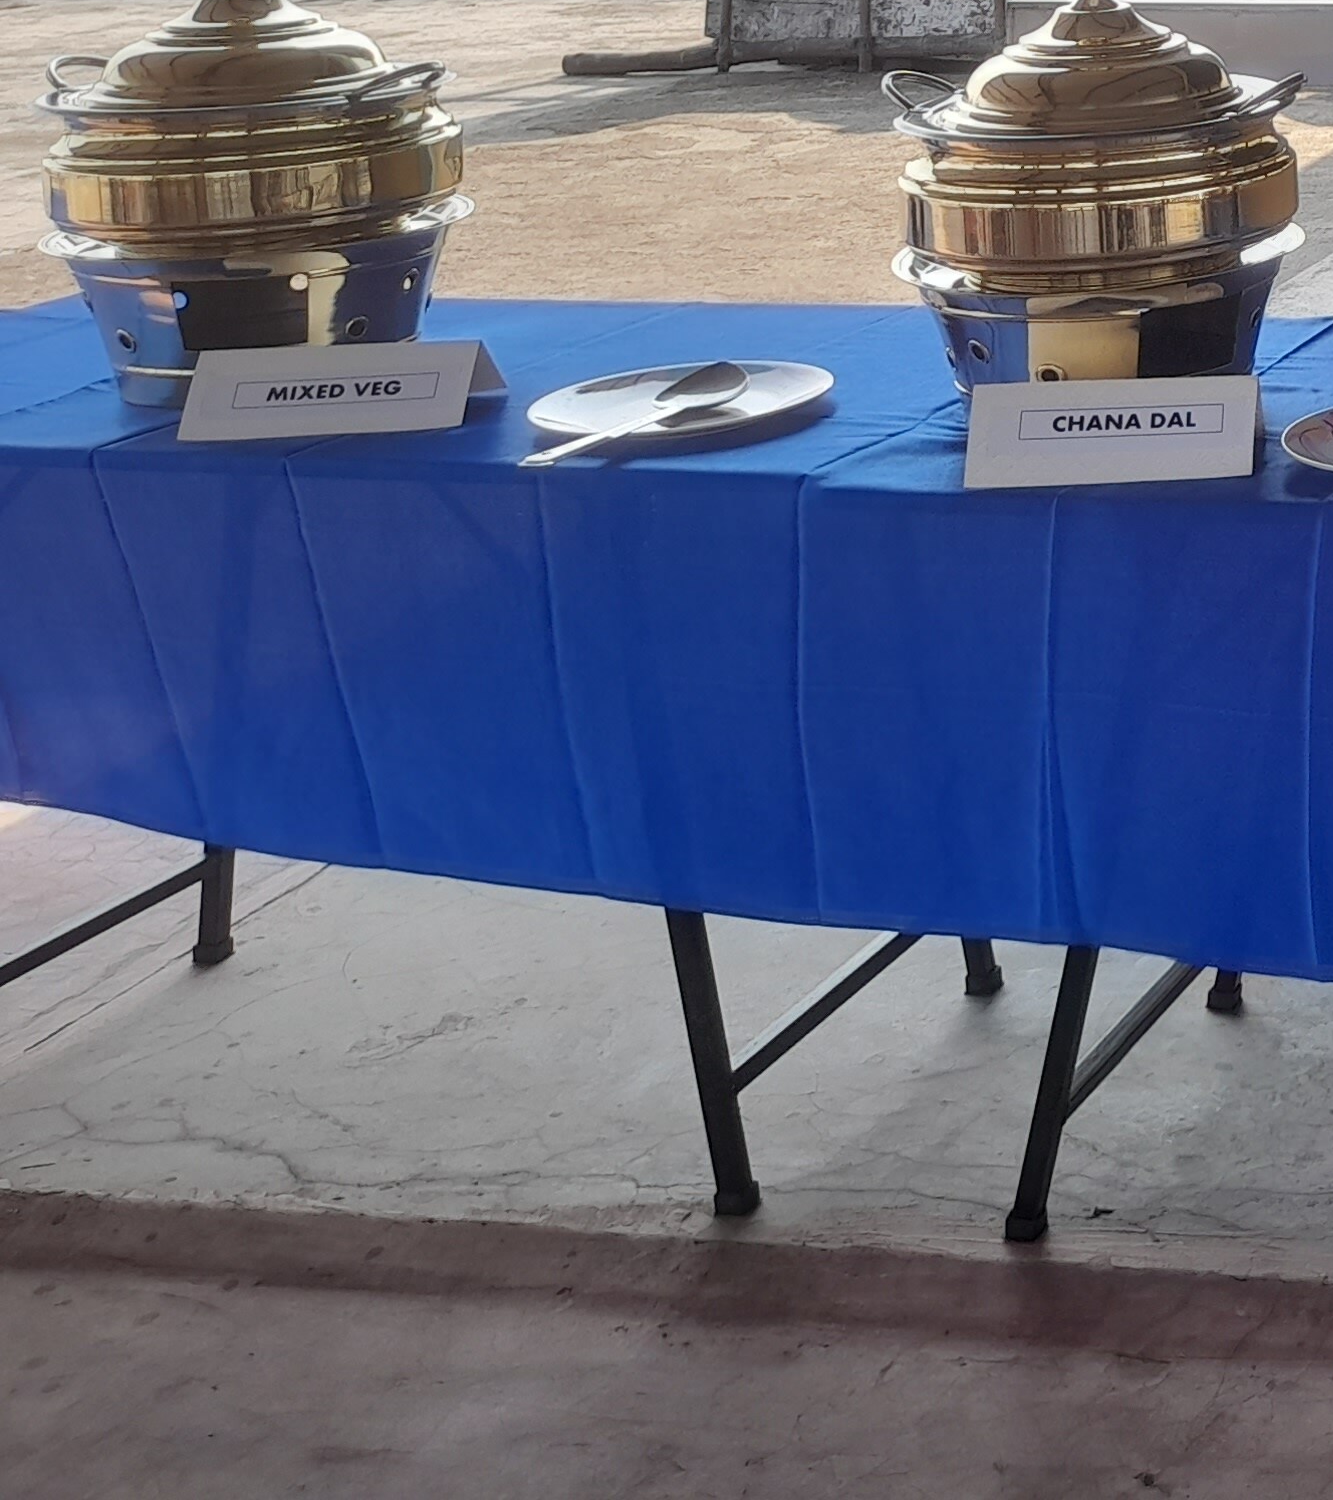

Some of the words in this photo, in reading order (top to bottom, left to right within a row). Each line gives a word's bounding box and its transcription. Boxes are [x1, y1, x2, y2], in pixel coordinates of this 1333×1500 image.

[266, 383, 345, 402] MIXED
[354, 379, 402, 397] VEG
[1052, 413, 1141, 433] CHANA
[1150, 410, 1197, 429] DAL
